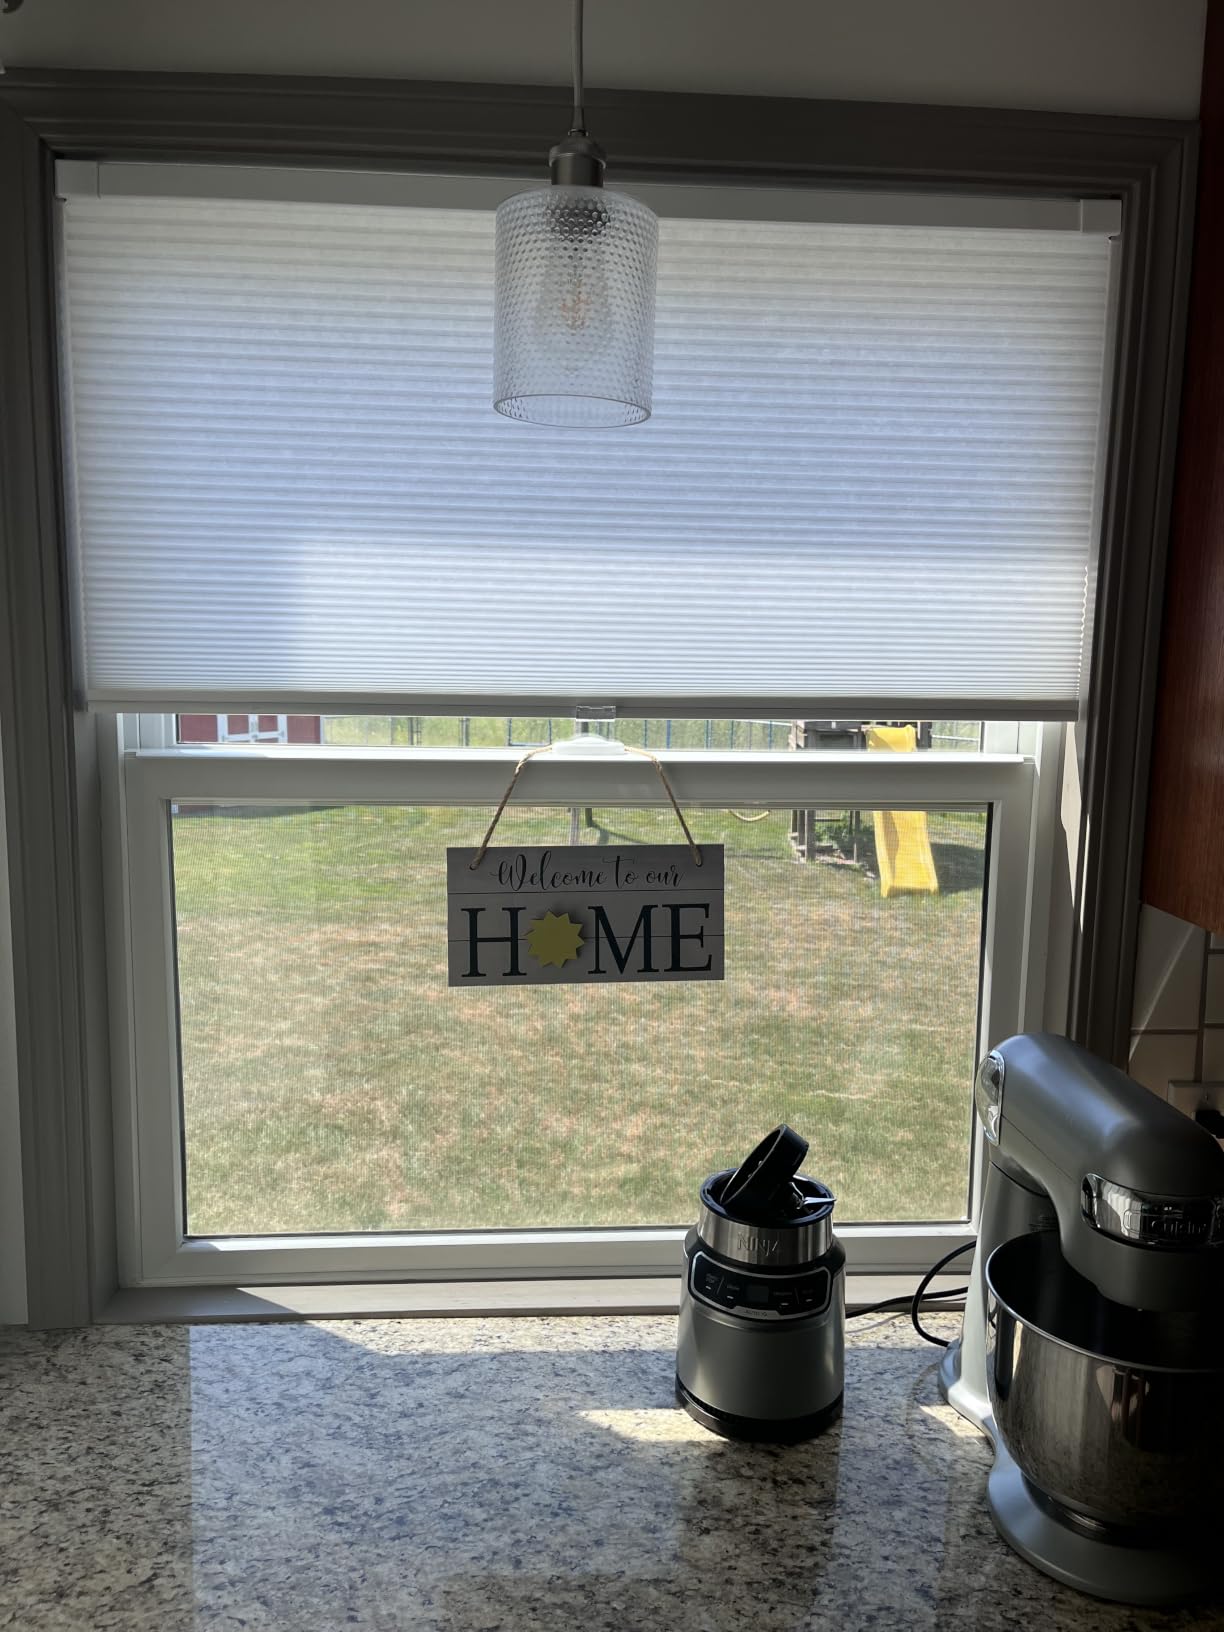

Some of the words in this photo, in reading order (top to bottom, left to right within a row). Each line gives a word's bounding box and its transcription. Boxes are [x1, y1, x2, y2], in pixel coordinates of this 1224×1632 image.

[489, 850, 607, 892] Welcome
[602, 855, 639, 889] to
[645, 862, 685, 889] our
[460, 902, 714, 978] HME
